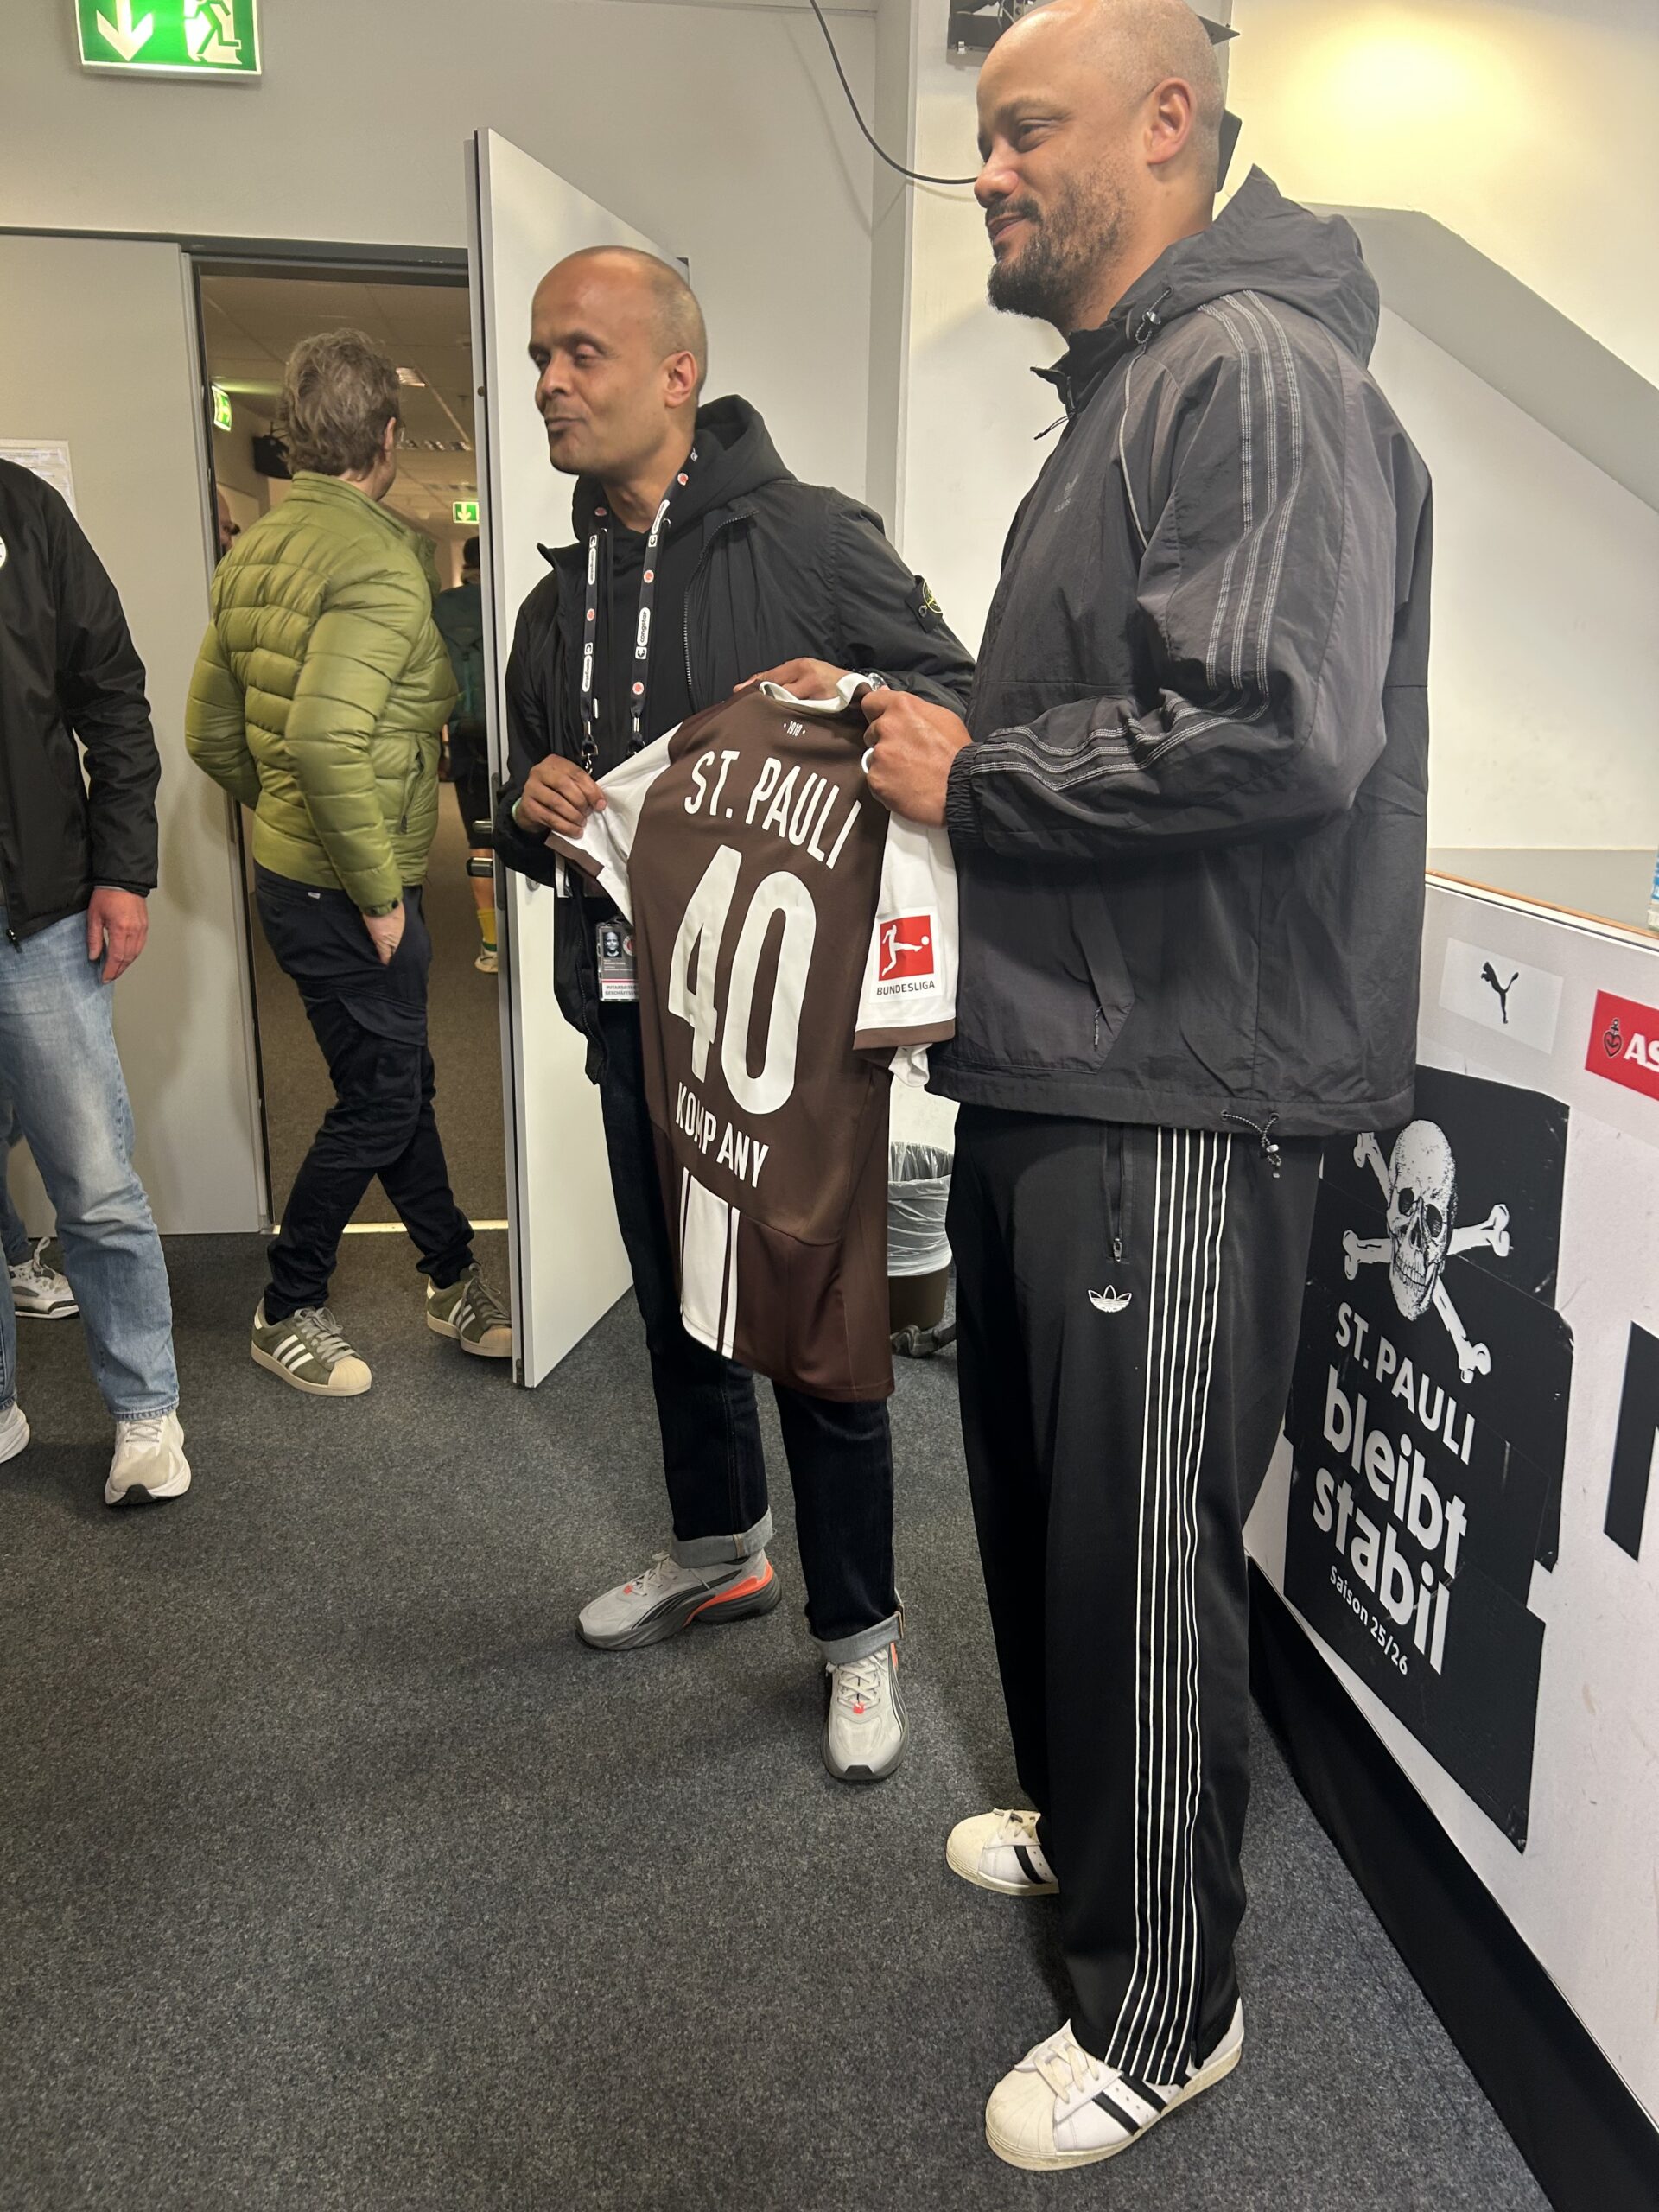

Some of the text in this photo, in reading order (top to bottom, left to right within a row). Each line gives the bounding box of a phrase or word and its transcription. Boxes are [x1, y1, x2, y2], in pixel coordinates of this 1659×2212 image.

[684, 750, 861, 869] ST. PAULI
[668, 845, 816, 1114] 40
[876, 980, 936, 996] BUNDESLIGA
[1324, 1364, 1468, 1580] bleibt
[1313, 1467, 1450, 1675] stabil
[1370, 1616, 1408, 1675] 25/26
